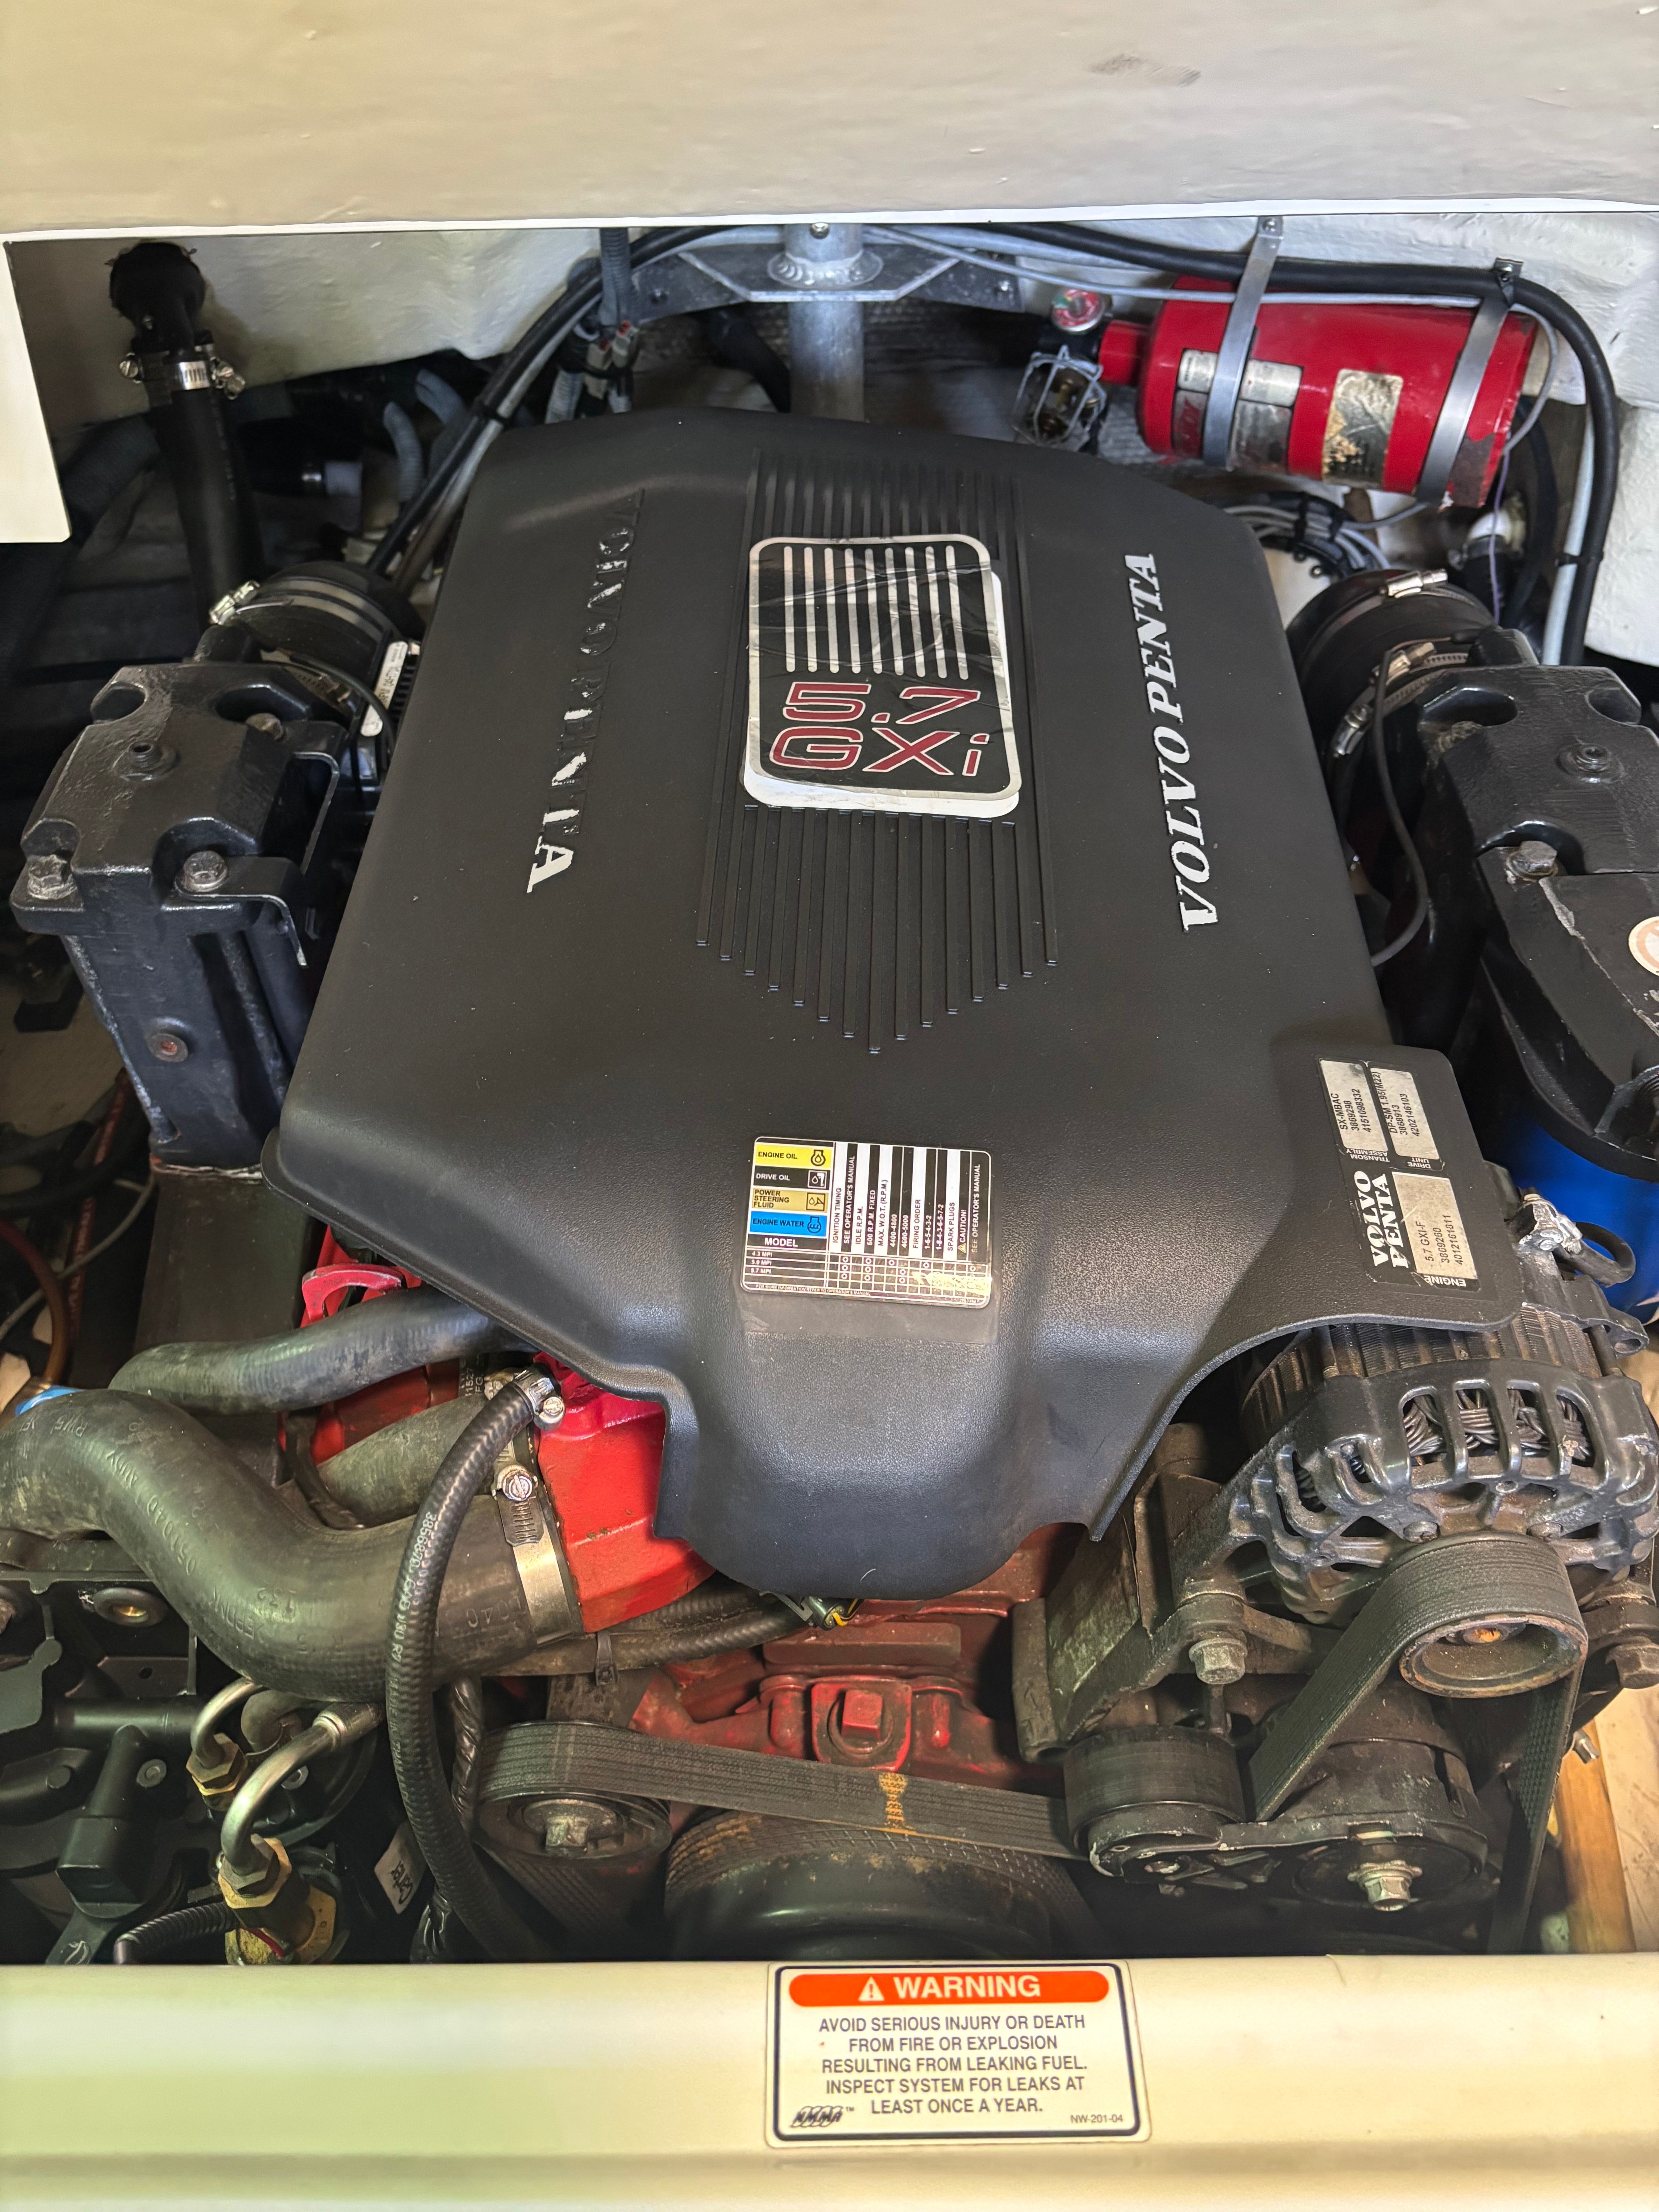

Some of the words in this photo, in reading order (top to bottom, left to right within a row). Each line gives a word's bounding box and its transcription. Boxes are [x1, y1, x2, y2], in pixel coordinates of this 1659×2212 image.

[1125, 553, 1183, 723] PENTA
[782, 682, 981, 725] 5.7
[769, 726, 989, 776] GXi
[1154, 726, 1218, 931] VOLVO
[1371, 1072, 1389, 1106] 1.95(M22)
[1331, 1093, 1348, 1130] SX-MBAC
[1343, 1101, 1359, 1131] 3869298
[1352, 1089, 1371, 1132] 4151098332
[1382, 1108, 1398, 1133] DP-SM
[1391, 1105, 1408, 1135] 3868913
[1400, 1094, 1420, 1136] 4202146103
[1350, 1154, 1390, 1162] TRANSOM
[845, 1184, 853, 1227] OPERATOR'S
[1354, 1171, 1389, 1266] VOLVO
[1372, 1173, 1408, 1268] PENTA
[764, 1237, 799, 1247] MODEL
[1415, 1221, 1430, 1246] GXI-F
[1432, 1227, 1449, 1263] 3869260
[1423, 1249, 1434, 1261] 5.7
[1424, 1275, 1467, 1287] ENGINE
[893, 1975, 1041, 1999] WARNING
[819, 2018, 866, 2032] AVOID
[871, 2016, 941, 2031] SERIOUS
[945, 2015, 1000, 2030] INJURY
[1006, 2015, 1028, 2030] OR
[1034, 2014, 1085, 2029] DEATH
[849, 2038, 894, 2052] FROM
[899, 2037, 934, 2051] FIRE
[939, 2037, 962, 2051] OR
[967, 2035, 1058, 2050] EXPLOSION
[822, 2057, 911, 2073] RESULTING
[916, 2057, 962, 2072] FROM
[967, 2056, 1037, 2071] LEAKING
[1042, 2055, 1087, 2070] FUEL.
[826, 2079, 895, 2094] INSPECT
[899, 2078, 964, 2093] SYSTEM
[969, 2077, 1002, 2092] FOR
[1007, 2076, 1061, 2091] LEAKS
[1066, 2076, 1085, 2090] AT
[871, 2099, 923, 2114] LEAST
[928, 2098, 974, 2114] ONCE
[979, 2098, 990, 2113] A
[993, 2098, 1043, 2112] YEAR.
[1070, 2114, 1123, 2124] NW-201-04
